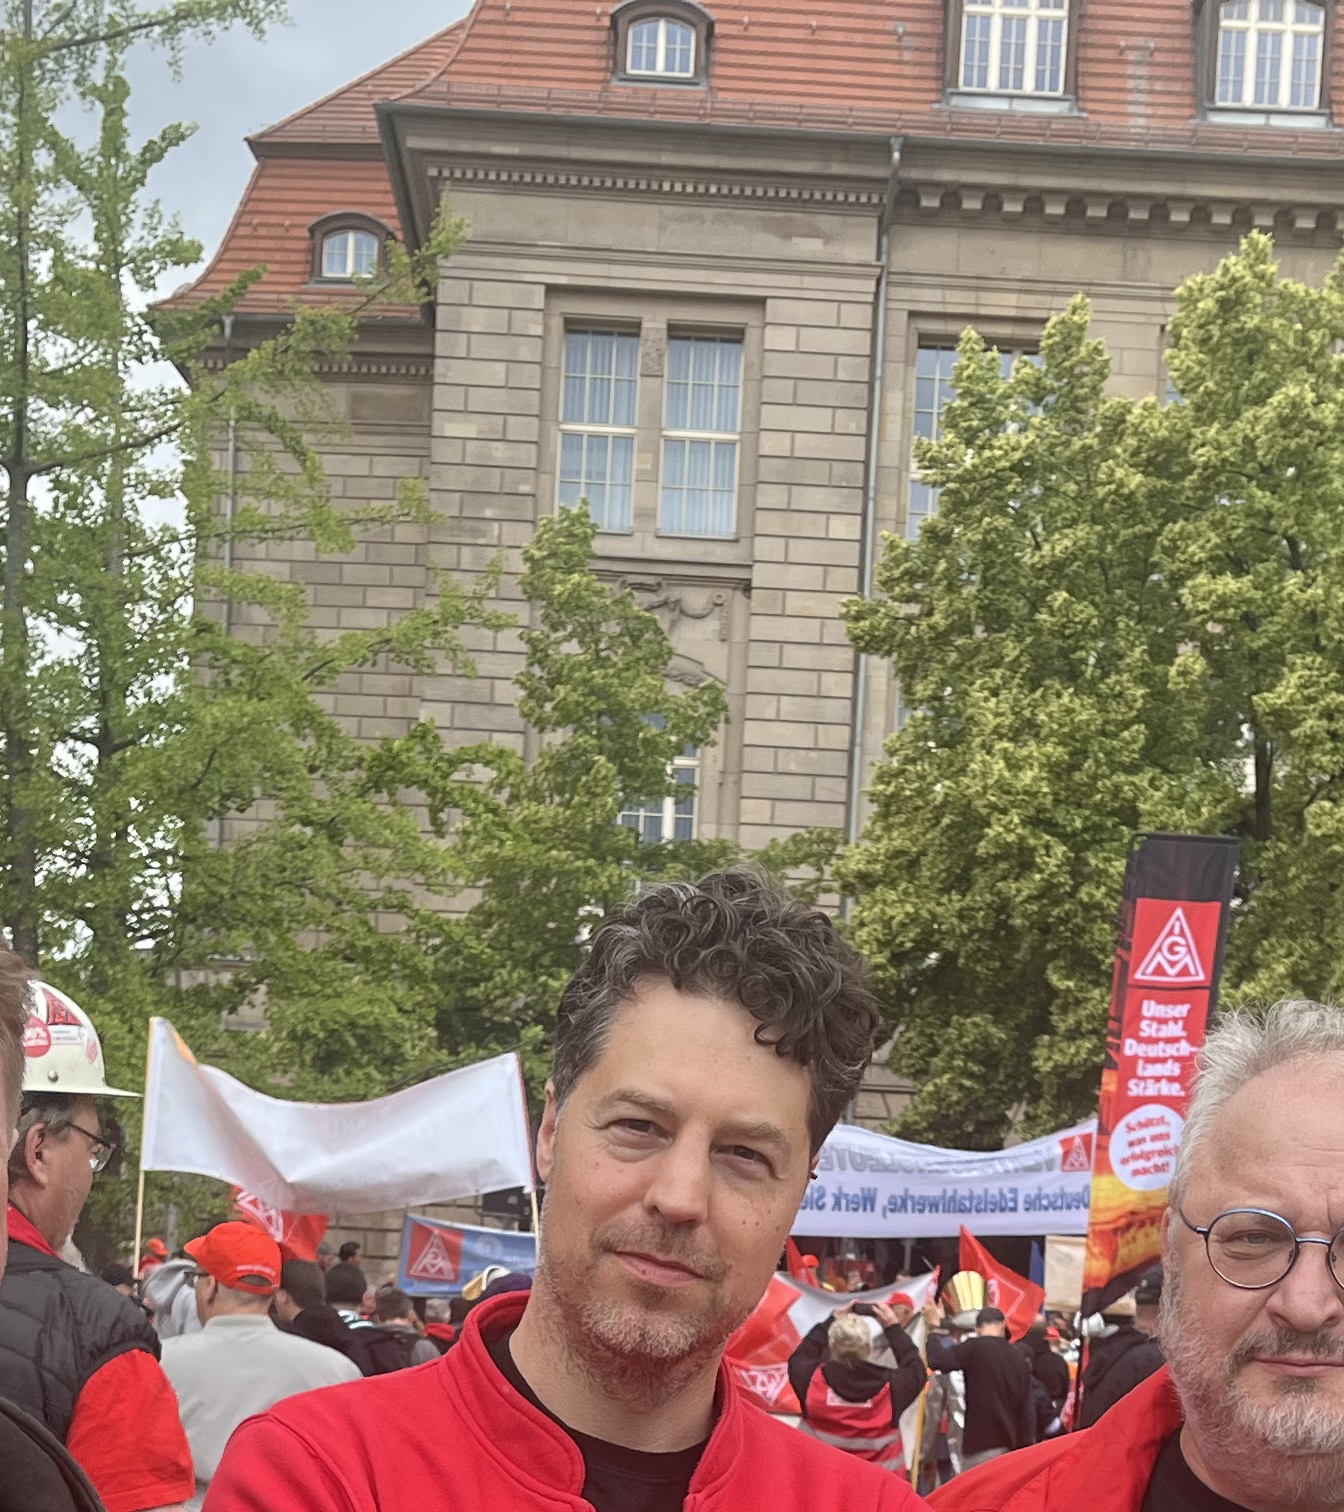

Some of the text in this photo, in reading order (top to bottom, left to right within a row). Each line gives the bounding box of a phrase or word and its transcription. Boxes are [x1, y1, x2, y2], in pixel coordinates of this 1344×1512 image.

[1141, 999, 1192, 1018] Unser
[1138, 1019, 1188, 1038] Stahl.
[1127, 1078, 1186, 1097] Stärke.
